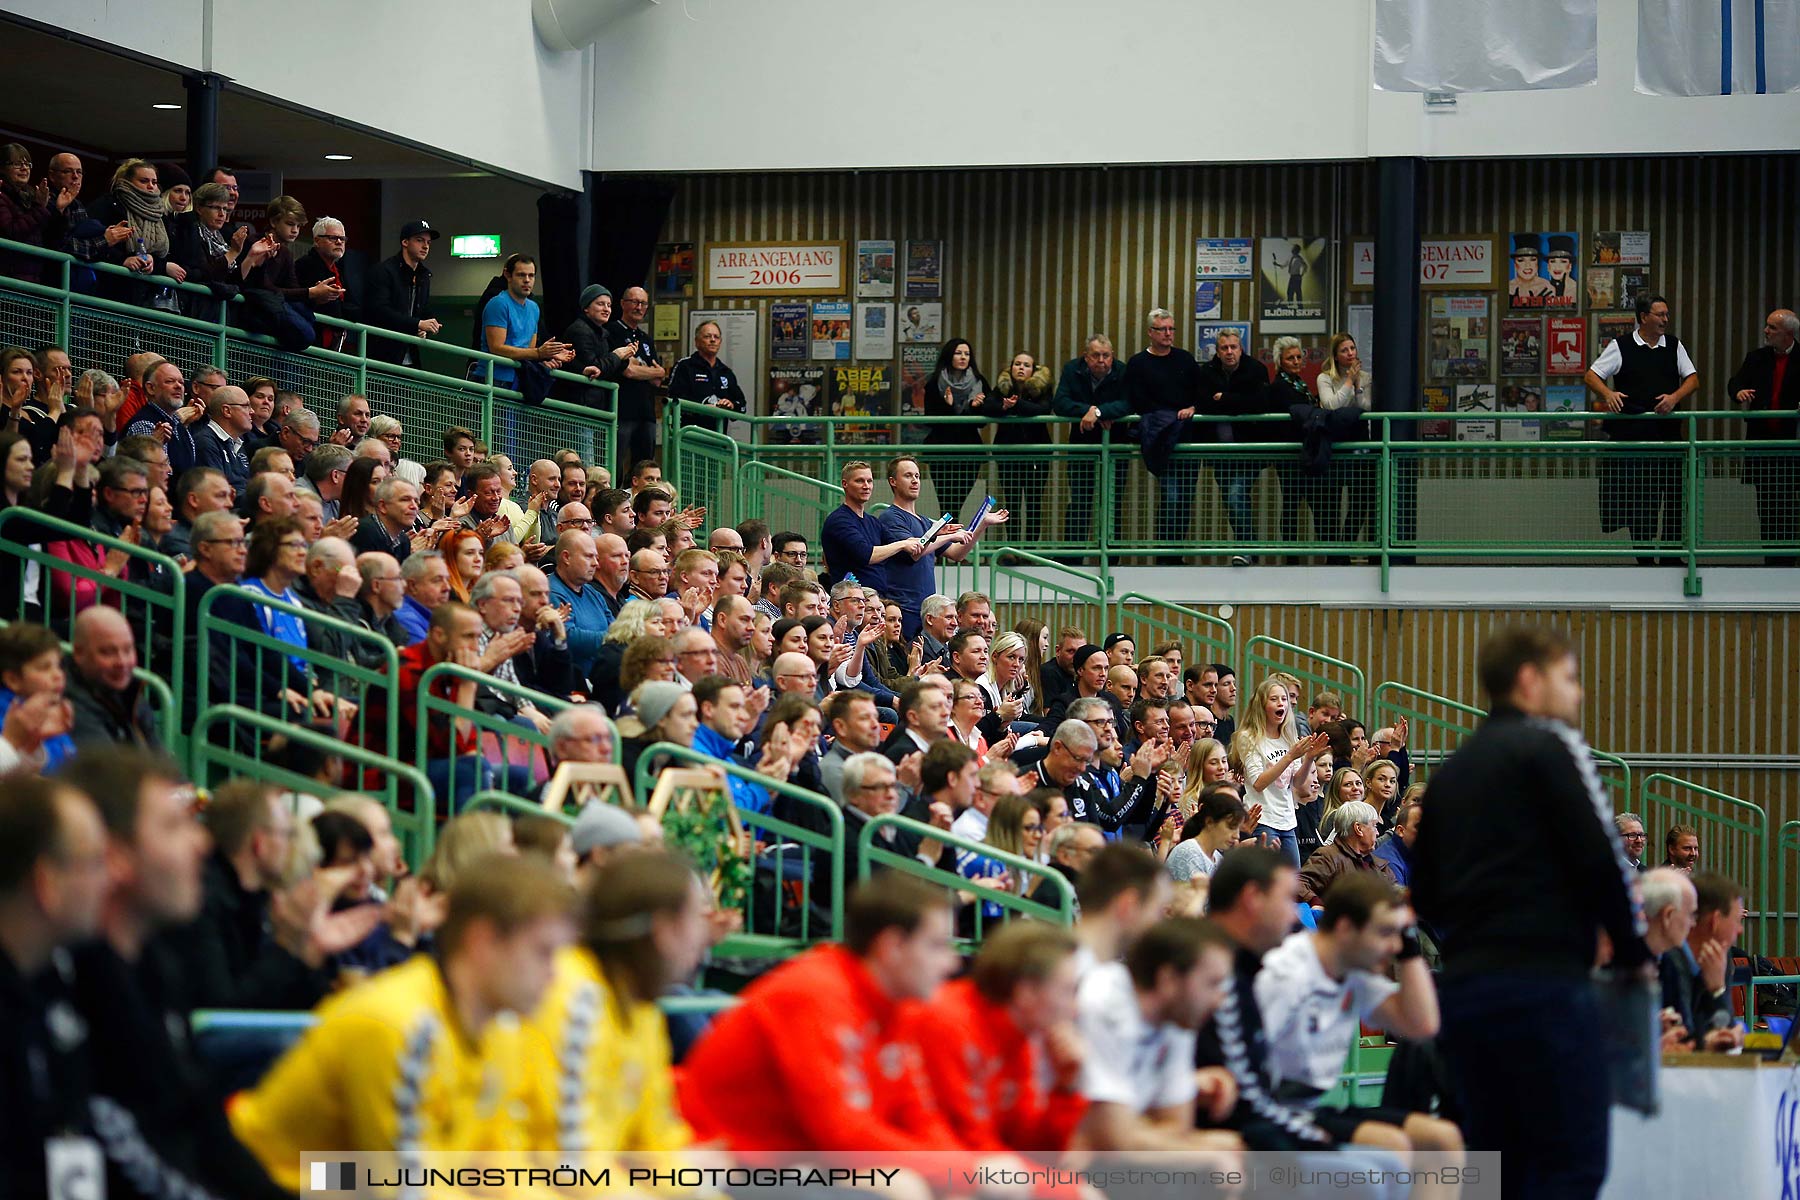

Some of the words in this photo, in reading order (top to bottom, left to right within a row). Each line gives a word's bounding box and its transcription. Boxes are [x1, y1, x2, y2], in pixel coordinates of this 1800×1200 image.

[717, 250, 833, 268] ARRANGEMANG
[749, 269, 801, 285] 2006
[1512, 296, 1544, 307] AFTER
[1546, 296, 1573, 306] DARK
[1264, 308, 1294, 316] BJÖRN
[1296, 308, 1321, 316] SKIFS
[770, 370, 802, 379] VIKING
[804, 370, 824, 378] CUP
[836, 369, 883, 382] ABBA
[1117, 783, 1143, 819] SALMING
